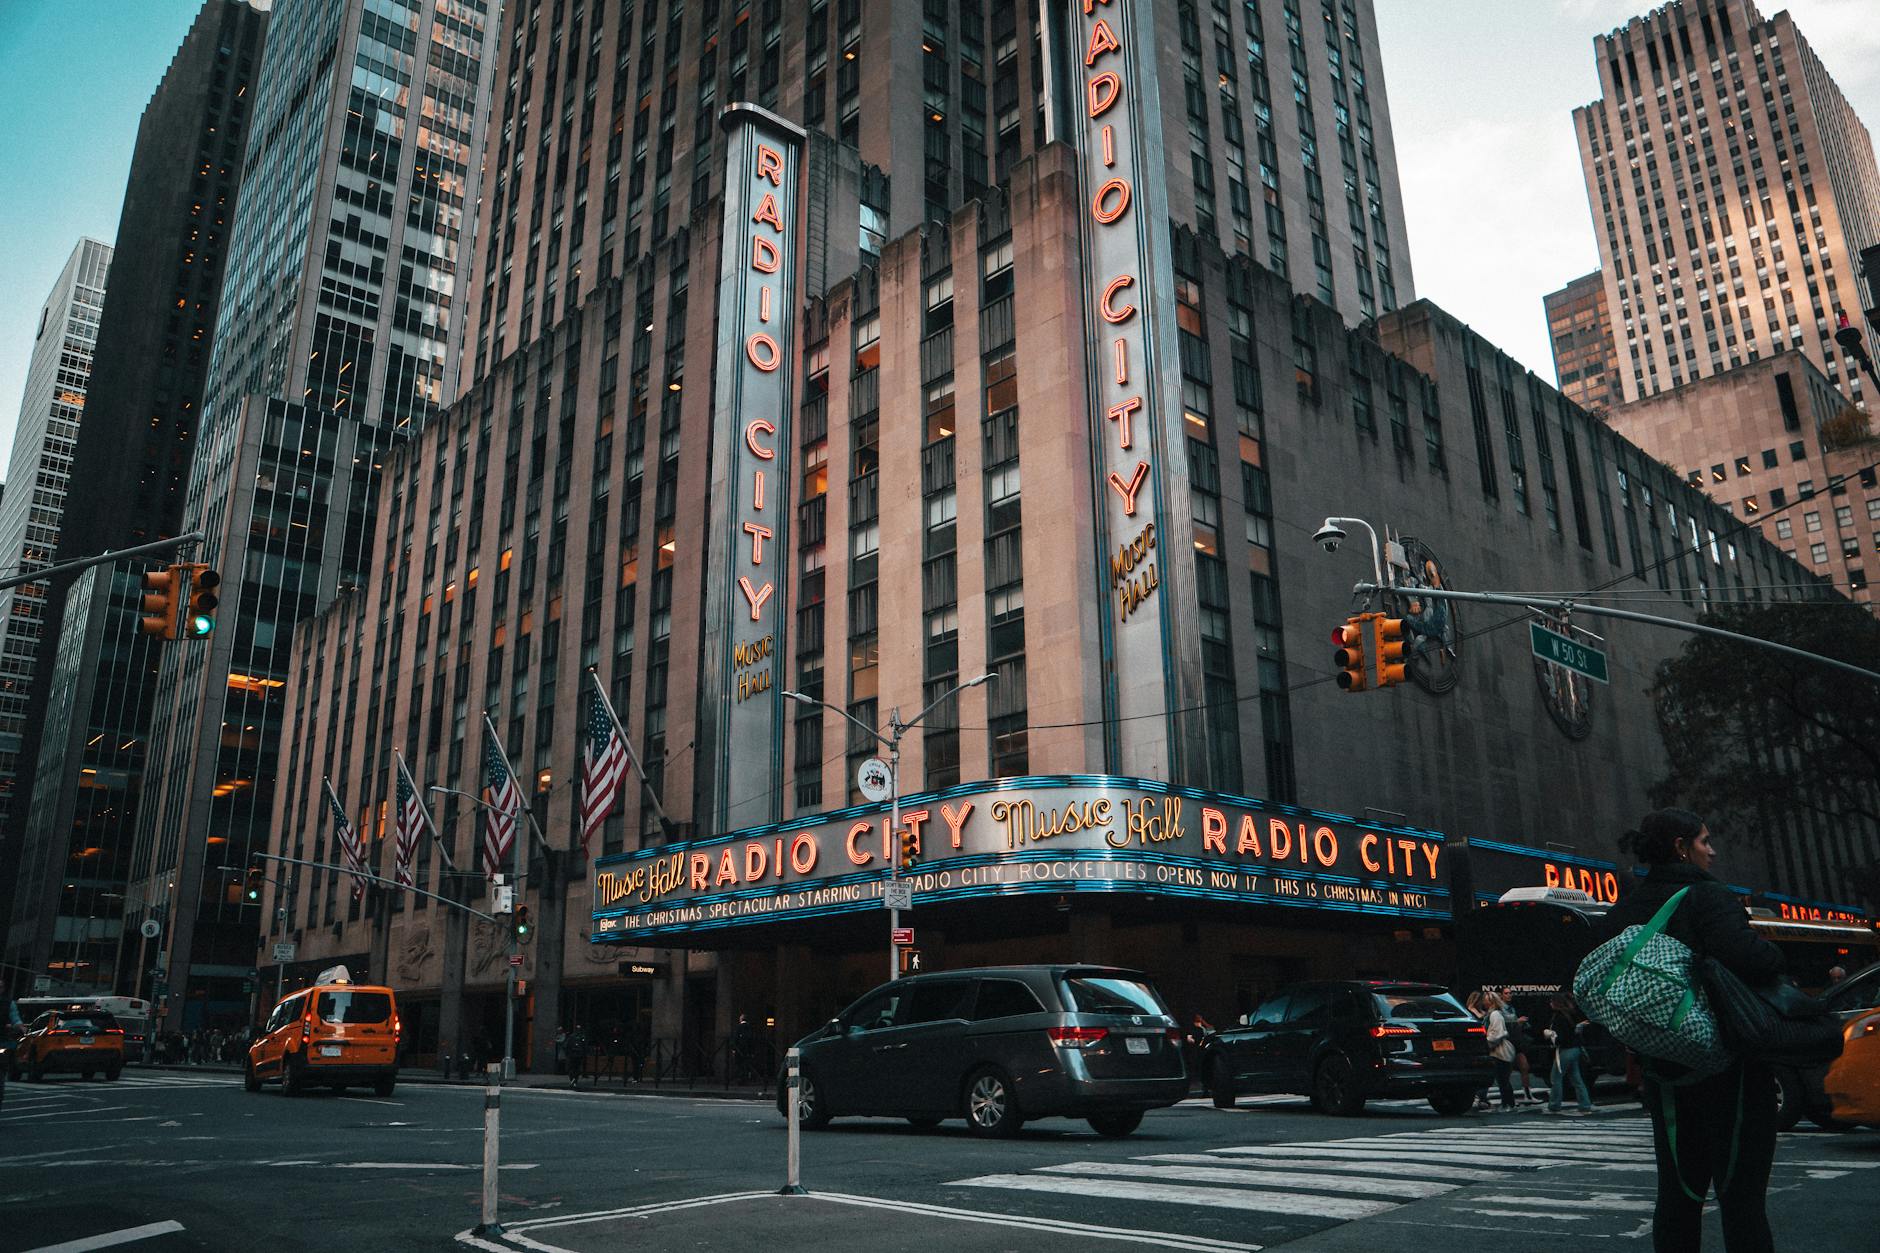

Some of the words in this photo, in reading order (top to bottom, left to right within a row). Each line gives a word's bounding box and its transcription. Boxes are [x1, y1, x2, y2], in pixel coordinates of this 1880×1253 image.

[745, 143, 784, 373] RADIO
[1100, 273, 1150, 517] CITY
[738, 419, 775, 621] CITY
[1551, 638, 1560, 657] W
[1561, 643, 1575, 664] 50
[1576, 649, 1588, 669] St
[598, 867, 644, 907] Music
[640, 851, 685, 903] Hall
[690, 832, 818, 890] RADIO
[846, 801, 974, 866] CITY
[991, 798, 1114, 848] Music
[1106, 796, 1185, 848] Hall
[1202, 807, 1338, 867] RADIO
[1360, 834, 1440, 880] CITY
[1545, 863, 1619, 903] RADIO
[625, 914, 641, 929] THE
[647, 906, 702, 926] CHRISTMAS
[709, 894, 790, 918] SPECTACULAR
[798, 884, 861, 907] STARRING
[871, 881, 885, 897] TH
[961, 865, 1002, 885] CITY
[1019, 861, 1146, 880] ROCKETTES
[1157, 865, 1203, 886] OPENS
[1211, 871, 1237, 890] NOV
[1246, 876, 1258, 892] 17
[1273, 878, 1299, 896] THIS
[1306, 882, 1318, 898] IS
[1324, 884, 1384, 904] CHRISTMAS
[1388, 891, 1399, 905] IN
[631, 965, 655, 975] Subway
[1481, 984, 1499, 992] NY
